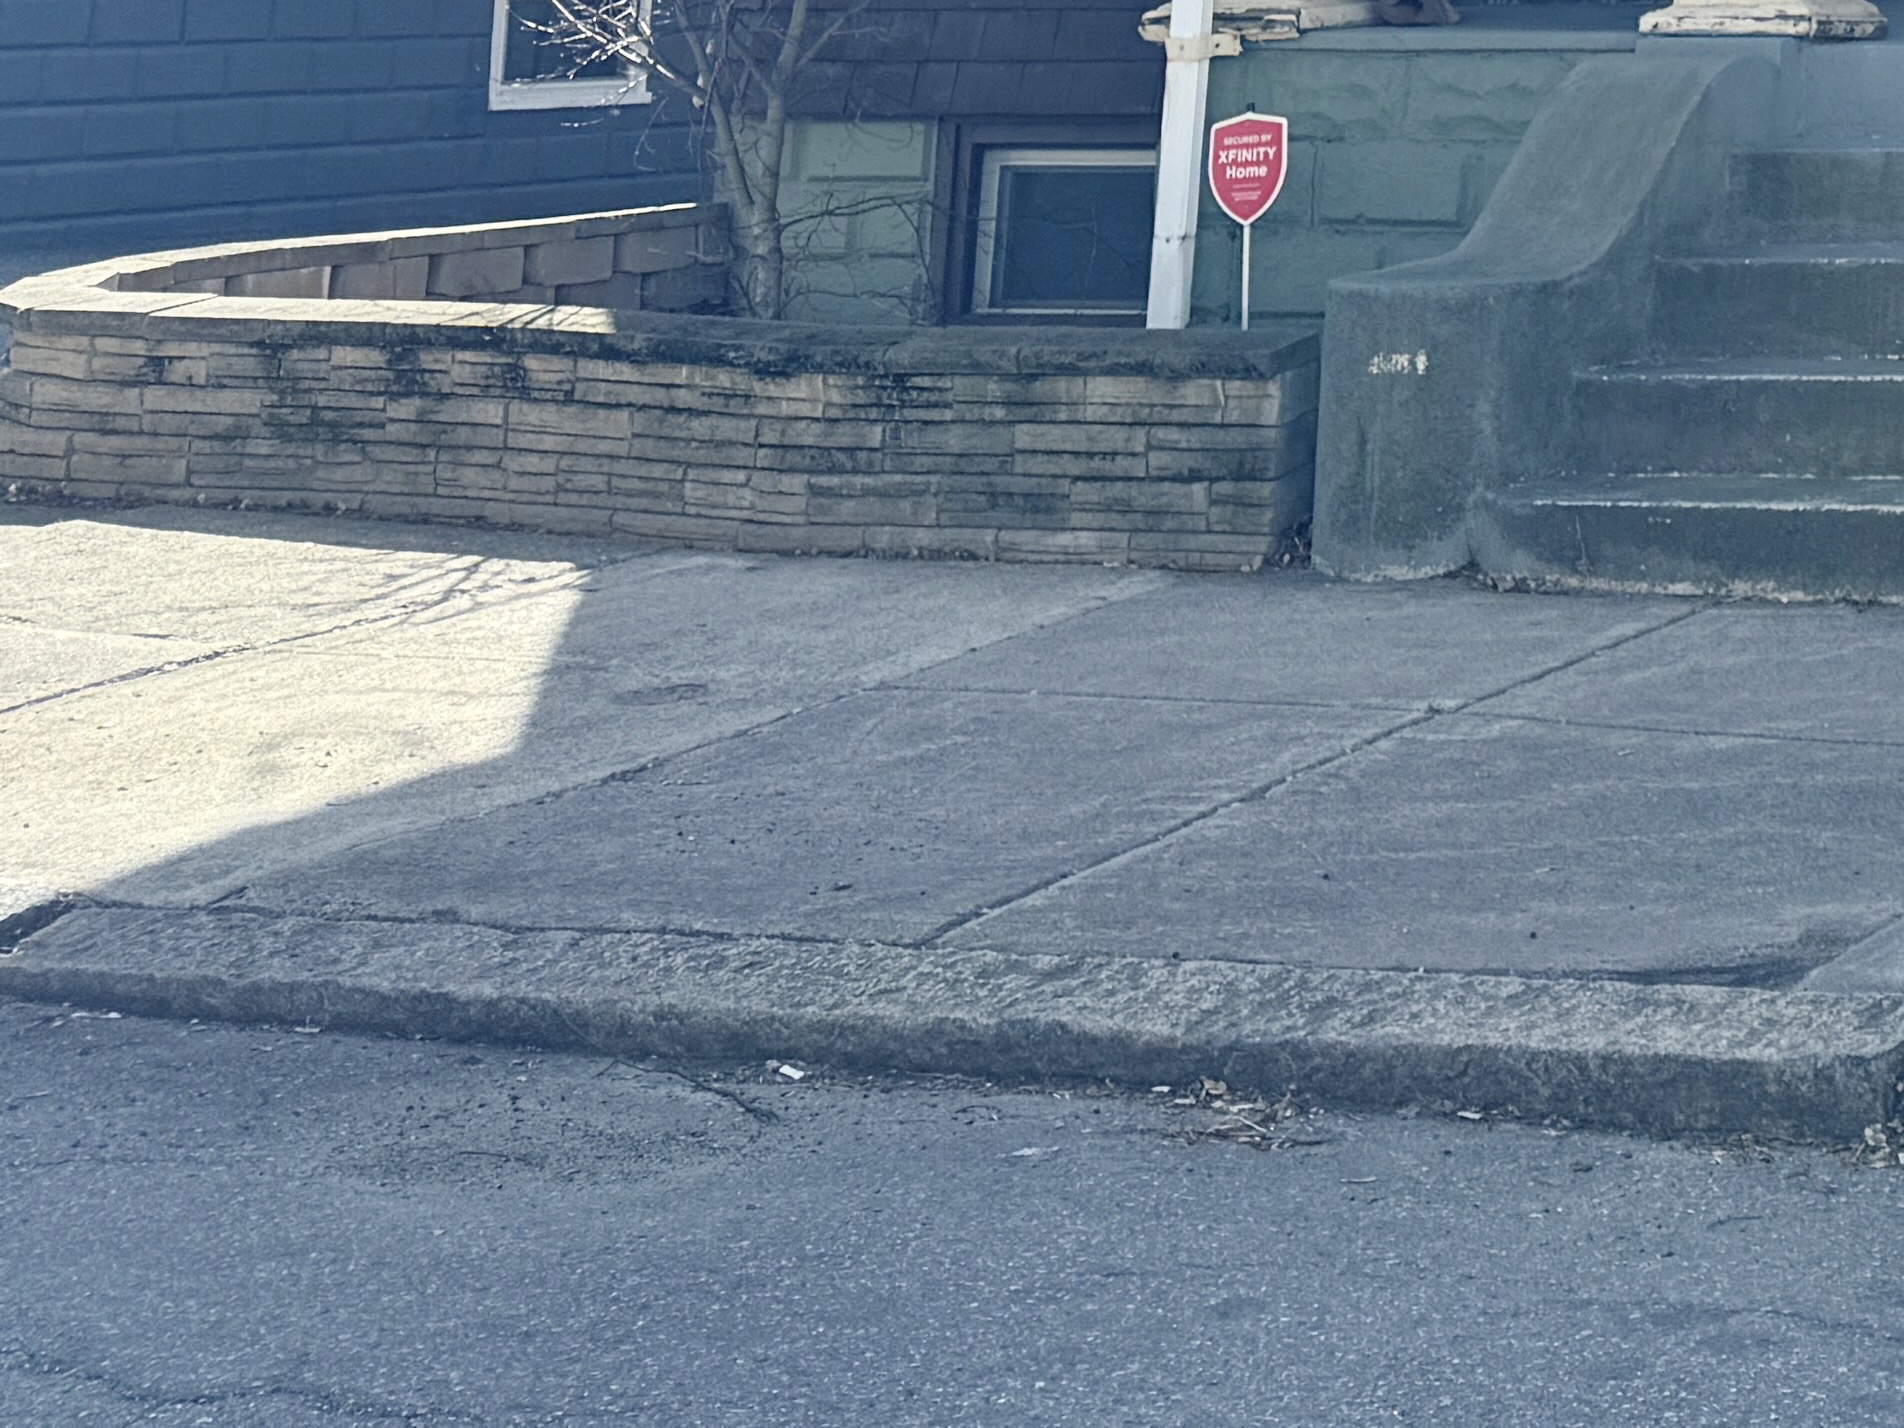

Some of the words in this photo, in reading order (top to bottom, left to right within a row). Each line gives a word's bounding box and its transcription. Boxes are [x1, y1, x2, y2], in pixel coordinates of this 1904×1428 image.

[1224, 135, 1259, 146] SECURED
[1261, 133, 1272, 143] BY
[1218, 146, 1277, 164] XFINITY
[1225, 165, 1268, 179] Home
